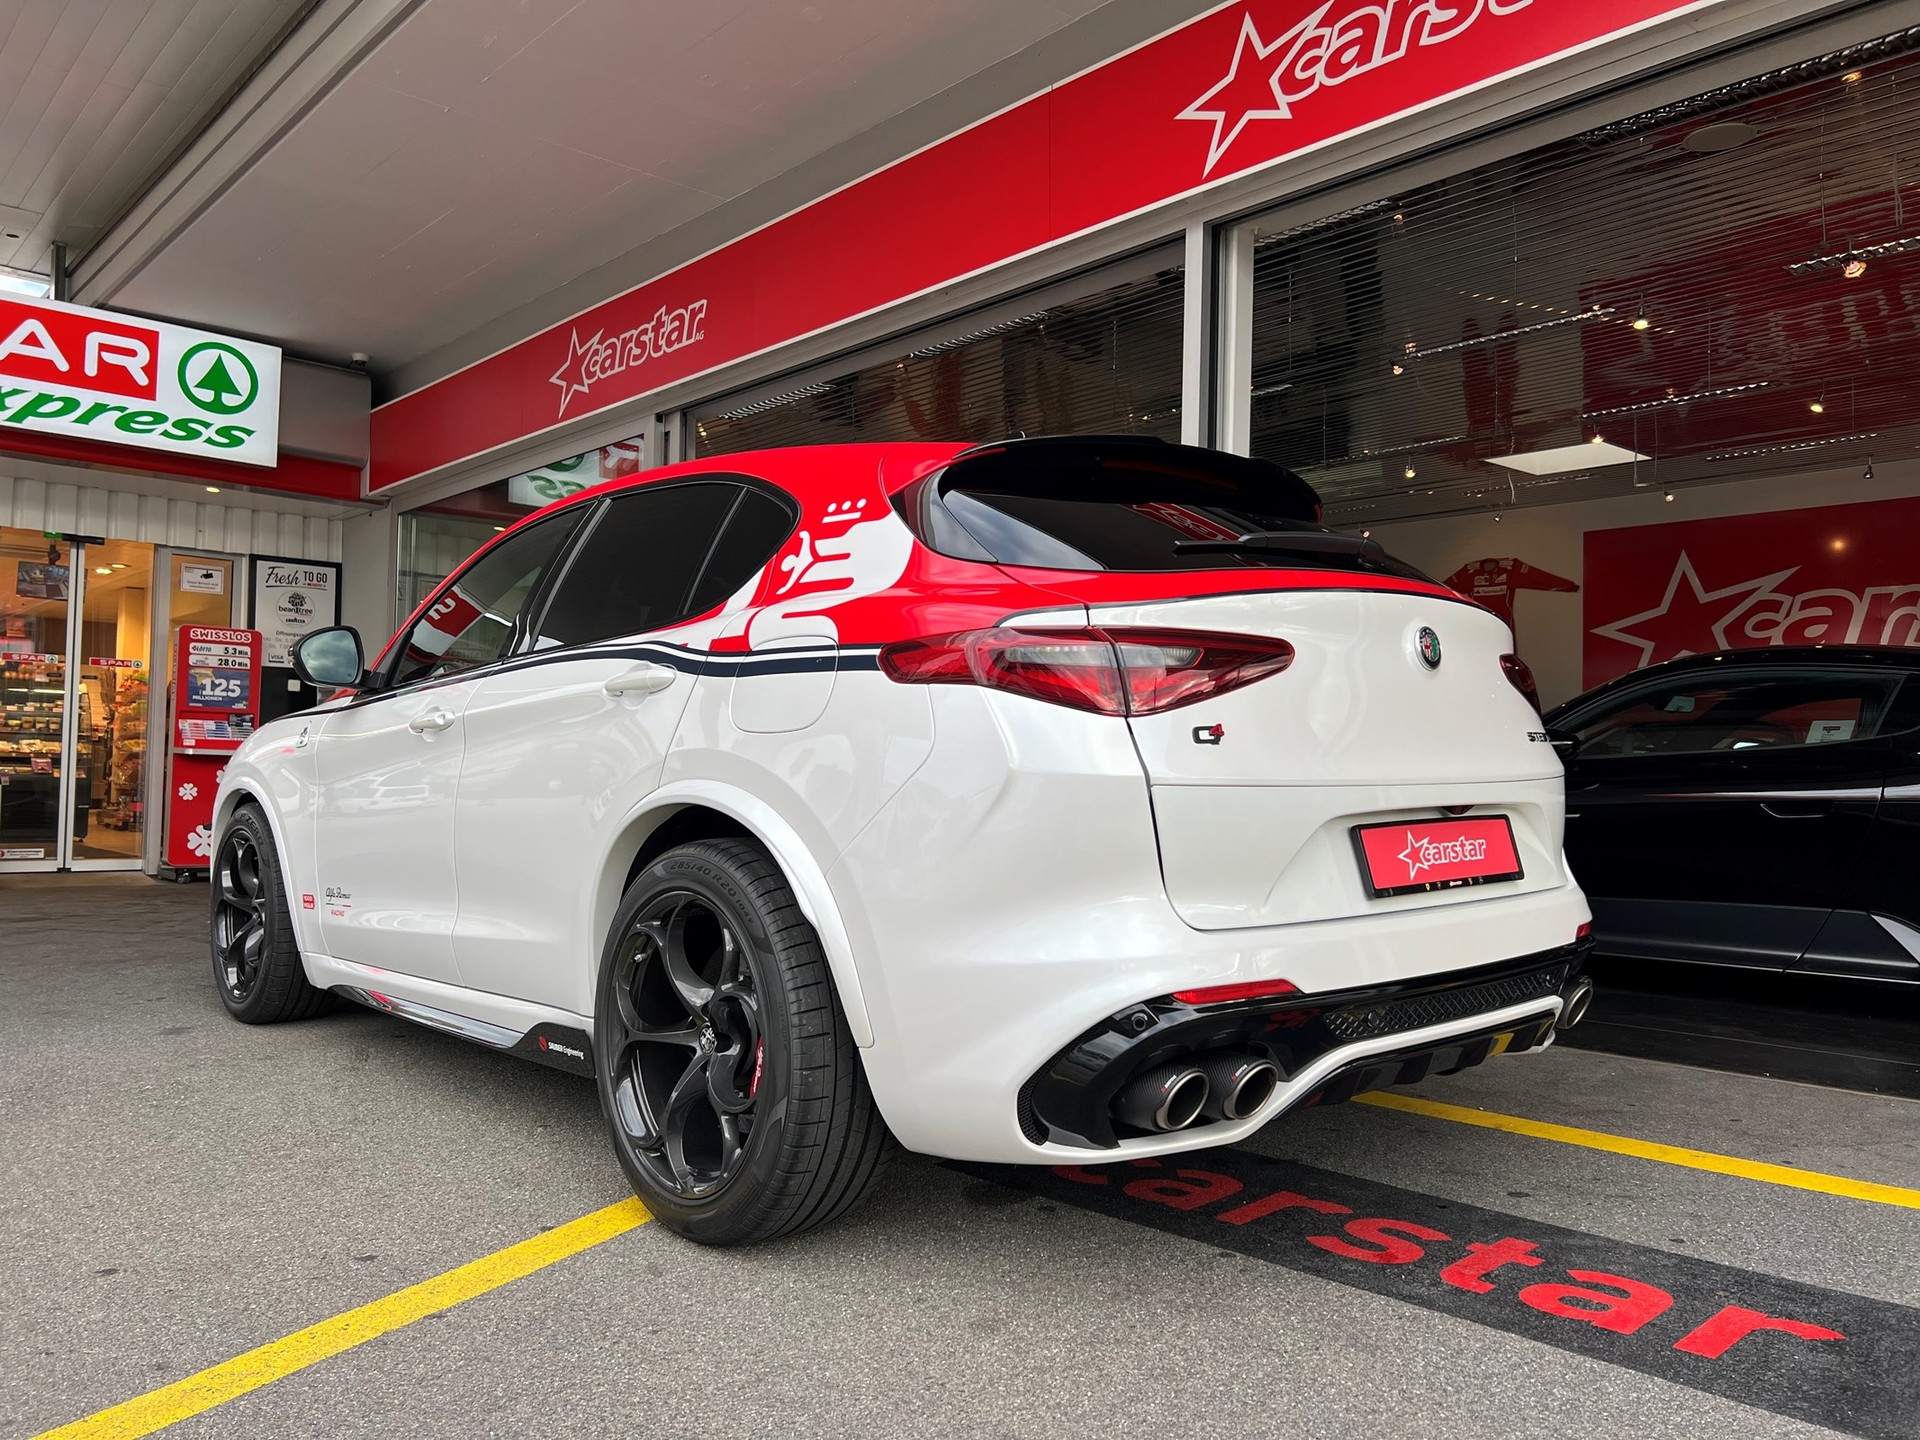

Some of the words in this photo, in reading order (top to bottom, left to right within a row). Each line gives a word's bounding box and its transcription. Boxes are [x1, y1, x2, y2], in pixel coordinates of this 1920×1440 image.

[1269, 0, 1533, 103] cars
[581, 299, 708, 386] carstar
[695, 330, 705, 342] AG
[265, 566, 300, 585] Fresh
[303, 570, 314, 582] TO
[316, 572, 328, 583] GO
[1711, 584, 1920, 648] car
[191, 629, 251, 643] SWISSLOS
[11, 653, 46, 662] SPAR
[99, 659, 132, 667] SPAR
[202, 678, 241, 697] 125
[1420, 835, 1487, 866] carstar
